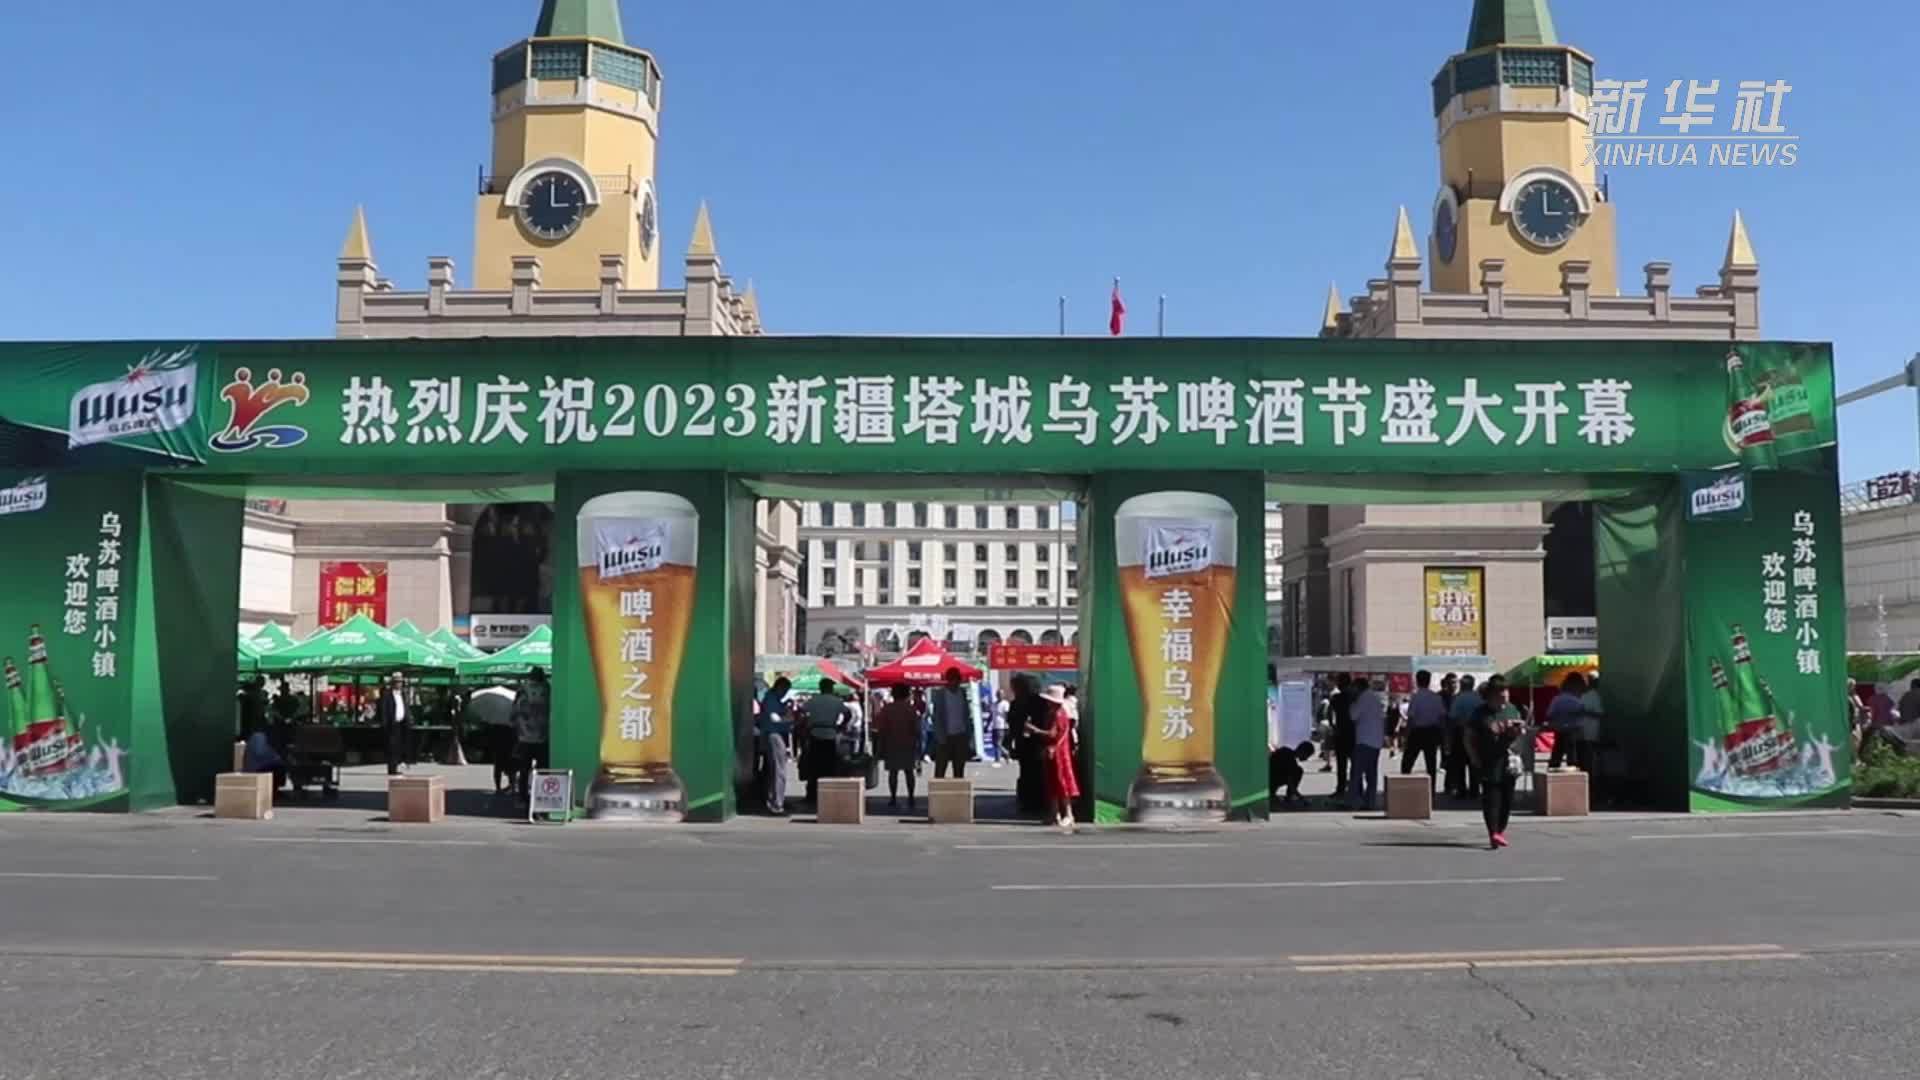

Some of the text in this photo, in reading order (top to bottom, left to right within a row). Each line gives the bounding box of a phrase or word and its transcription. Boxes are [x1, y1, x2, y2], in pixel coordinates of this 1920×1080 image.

[340, 375, 1637, 446] 热烈庆祝2023新疆塔城乌苏啤酒节盛大开幕
[63, 553, 91, 635] 欢迎您
[92, 511, 122, 678] 乌苏啤酒小镇
[619, 588, 654, 742] 啤酒之都
[1160, 588, 1193, 741] 幸福乌苏
[1762, 552, 1788, 633] 欢迎您
[1792, 510, 1821, 675] 乌苏啤酒小镇
